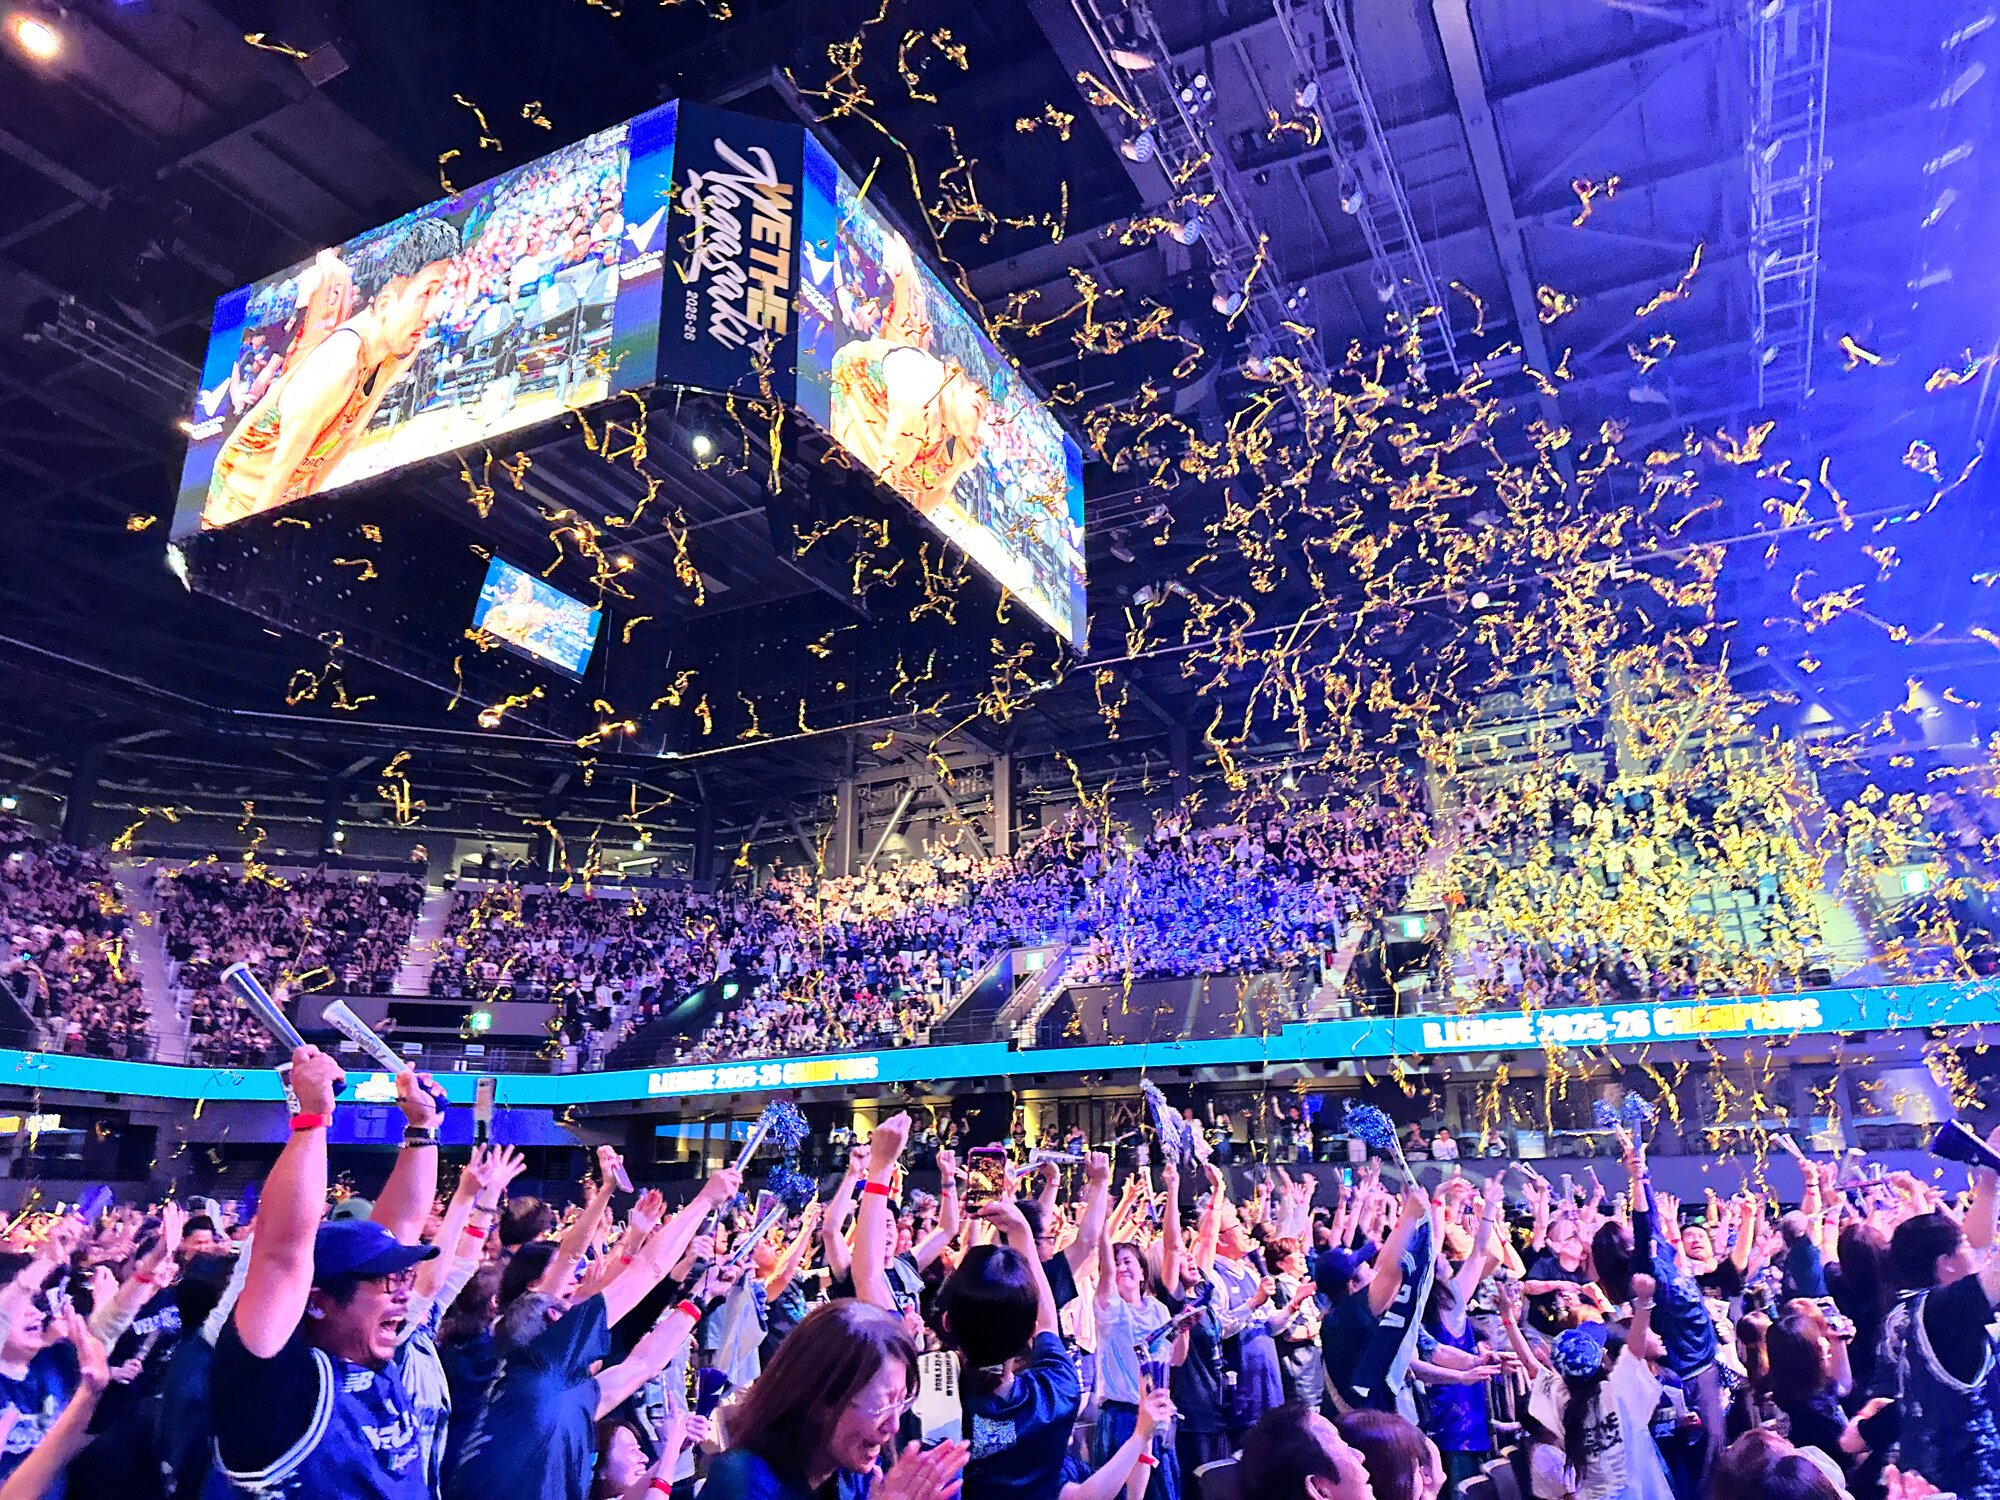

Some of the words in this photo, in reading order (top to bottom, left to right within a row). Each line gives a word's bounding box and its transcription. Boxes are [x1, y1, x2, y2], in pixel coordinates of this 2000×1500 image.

[682, 138, 778, 350] Nagasaki
[684, 290, 699, 341] 2025-26
[1422, 1017, 1537, 1048] B.LEAGUE
[1537, 1009, 1649, 1042] 2025-26
[1652, 998, 1823, 1036] CHAMPIONS
